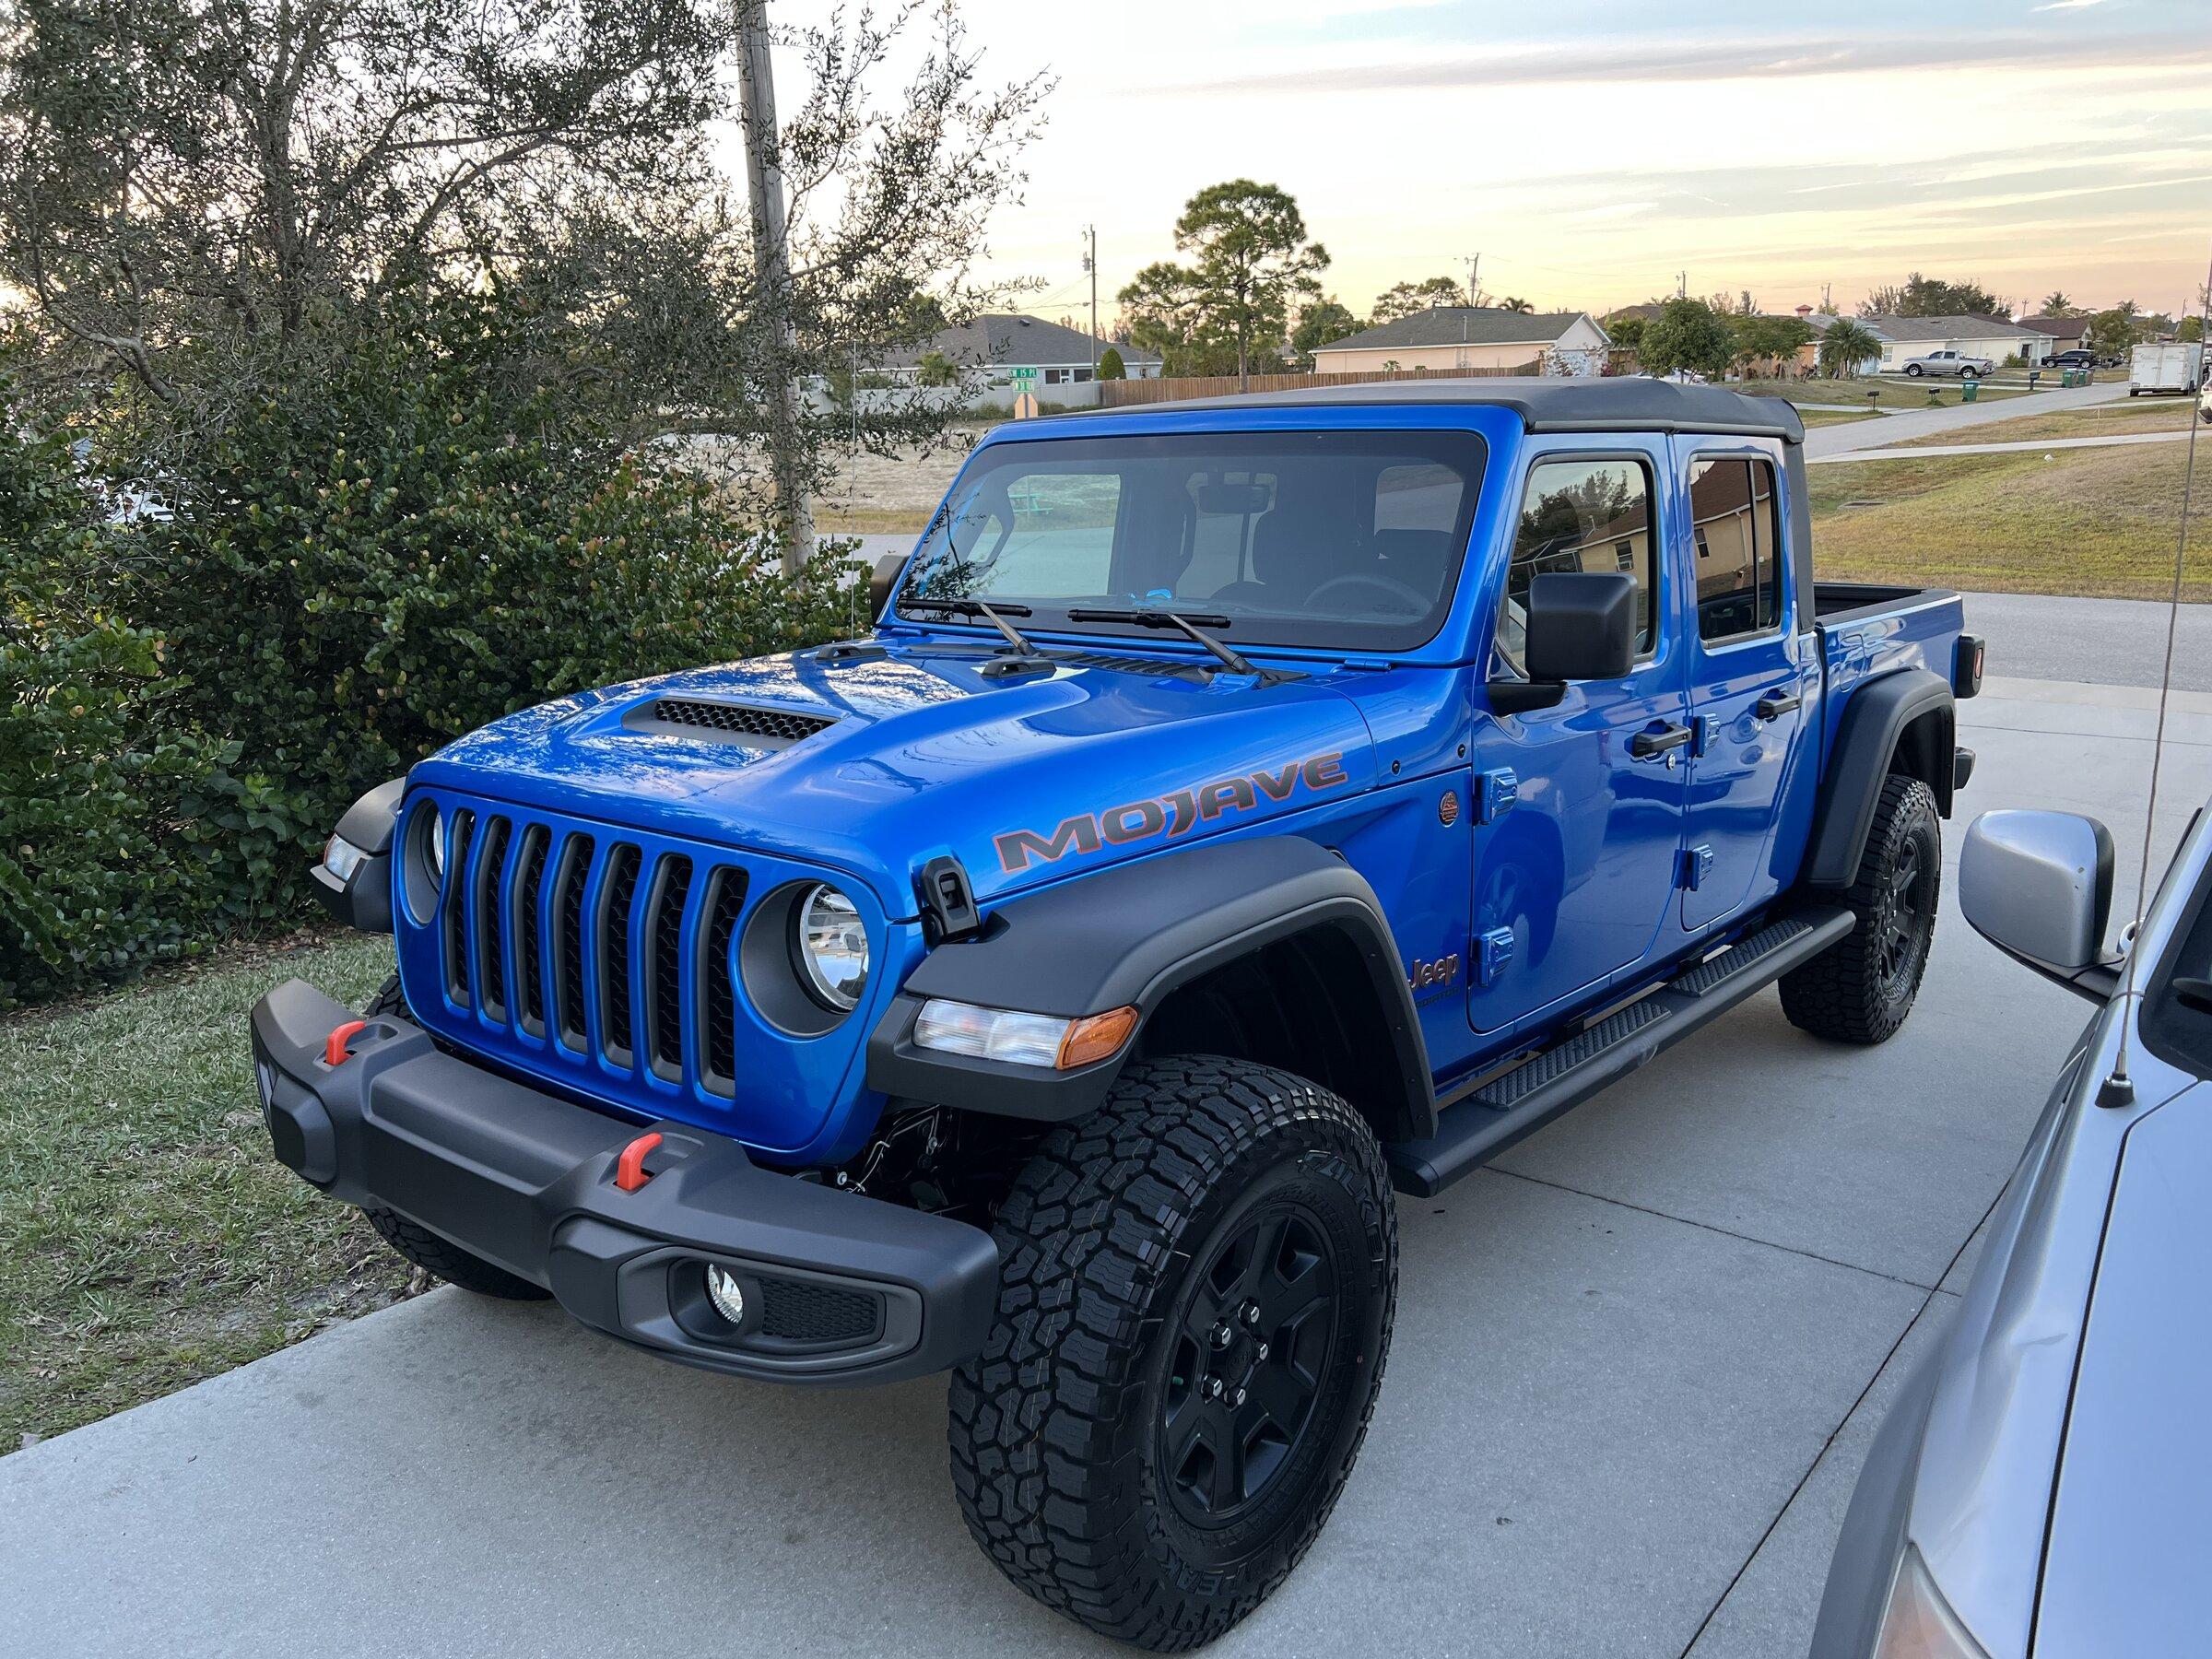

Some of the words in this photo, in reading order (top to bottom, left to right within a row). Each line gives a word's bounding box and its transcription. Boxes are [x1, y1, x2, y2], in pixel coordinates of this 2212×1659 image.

[1007, 369, 1018, 378] SW
[1020, 368, 1028, 378] 15
[1029, 368, 1037, 378] PL
[994, 752, 1347, 873] MOJAVE
[1407, 953, 1459, 993] Jeep
[1297, 1147, 1384, 1296] FALKEN
